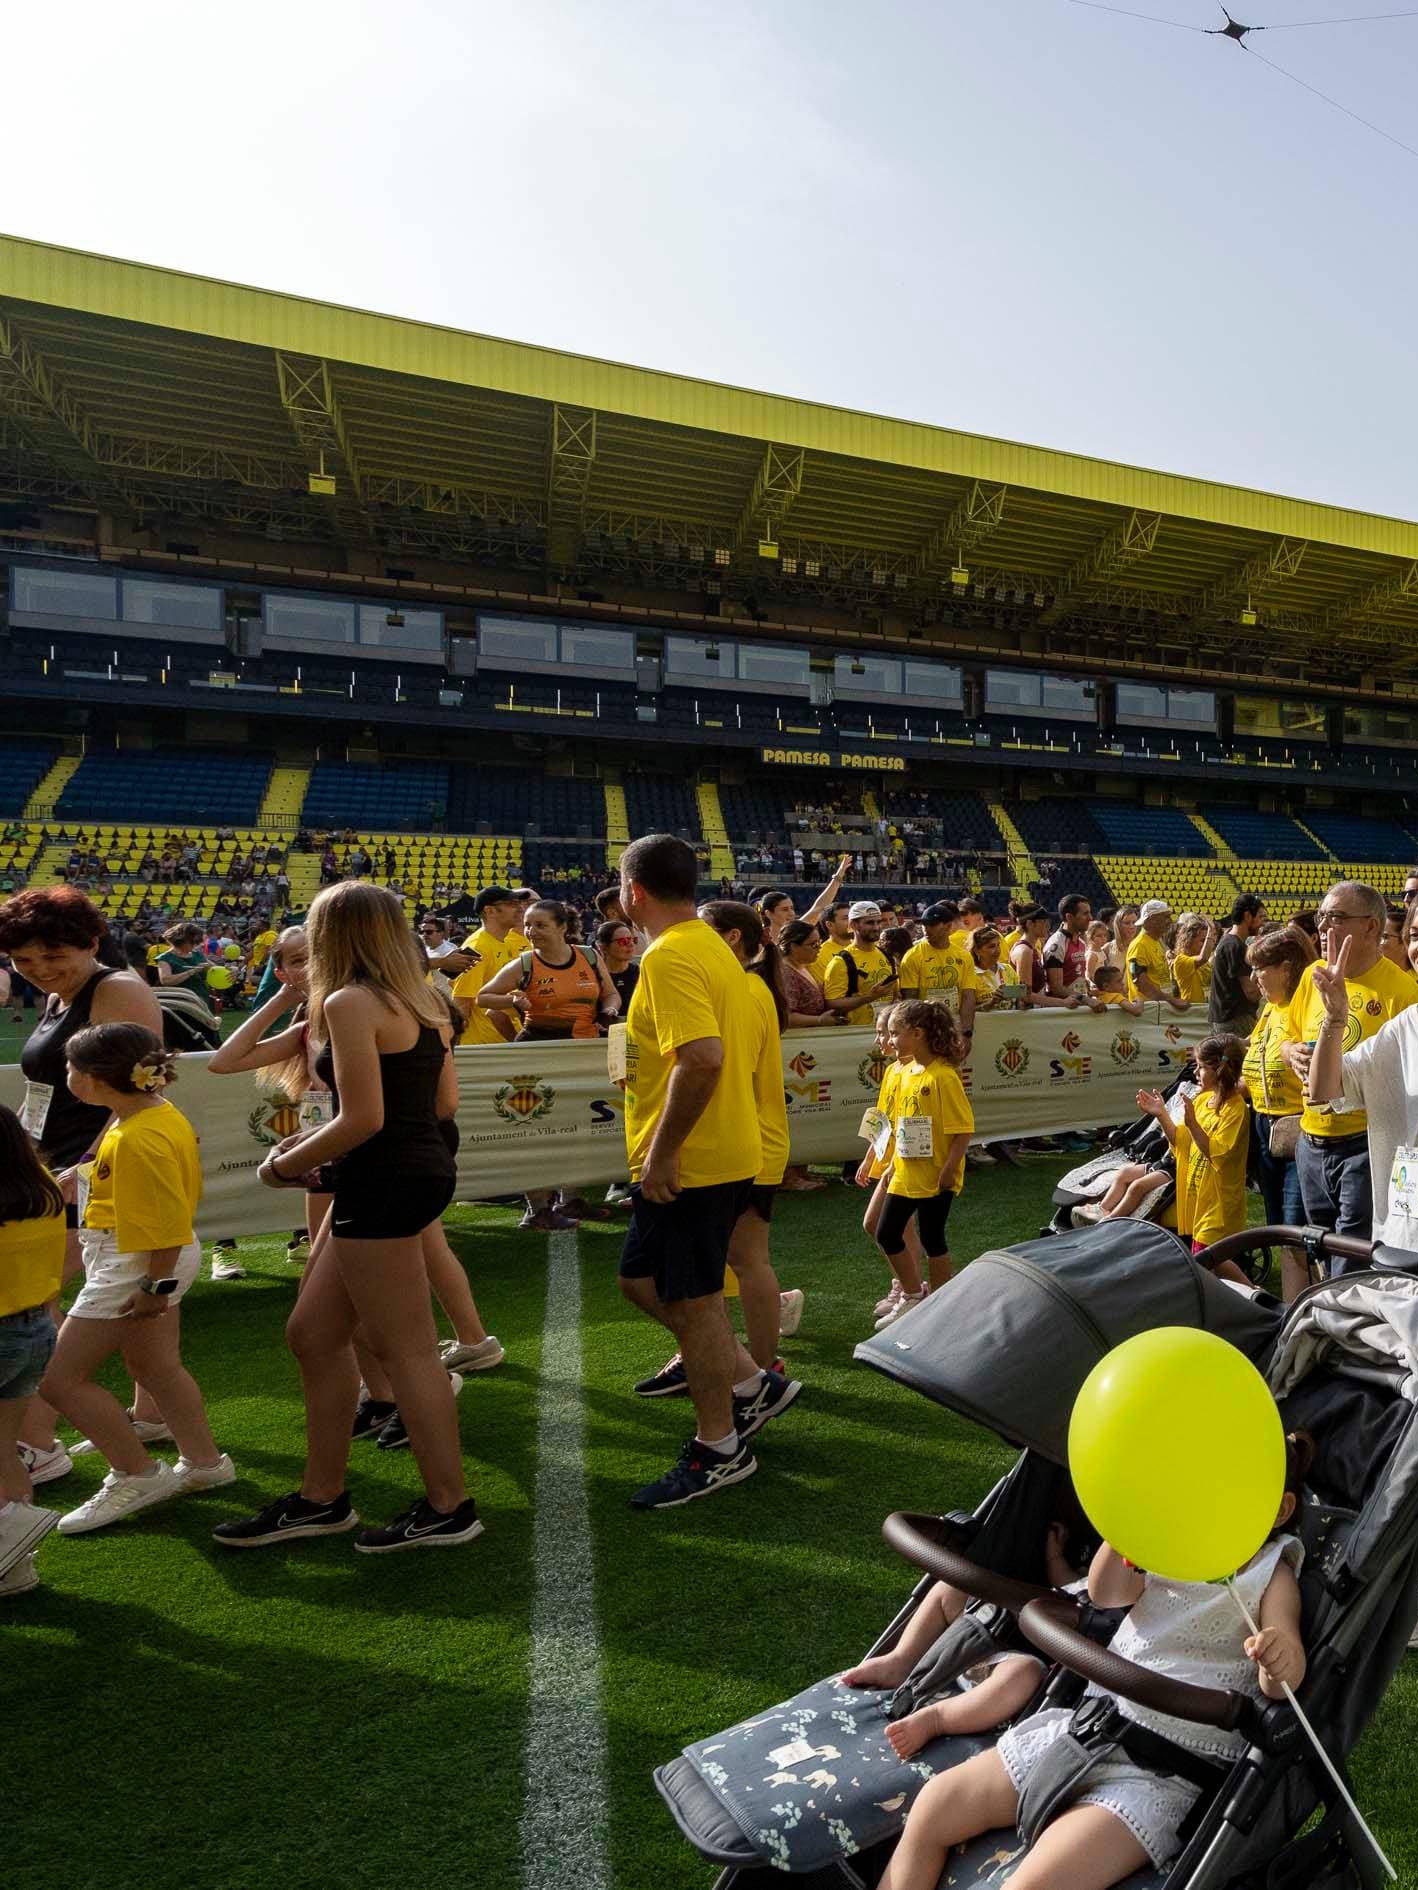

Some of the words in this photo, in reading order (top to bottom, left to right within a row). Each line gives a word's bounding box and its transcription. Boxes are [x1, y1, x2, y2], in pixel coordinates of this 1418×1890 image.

[763, 749, 830, 766] PAMESA
[841, 754, 905, 770] PAMESA
[1050, 1056, 1092, 1078] SME
[469, 1130, 527, 1144] Ajuntament
[537, 1125, 577, 1137] Vila-real
